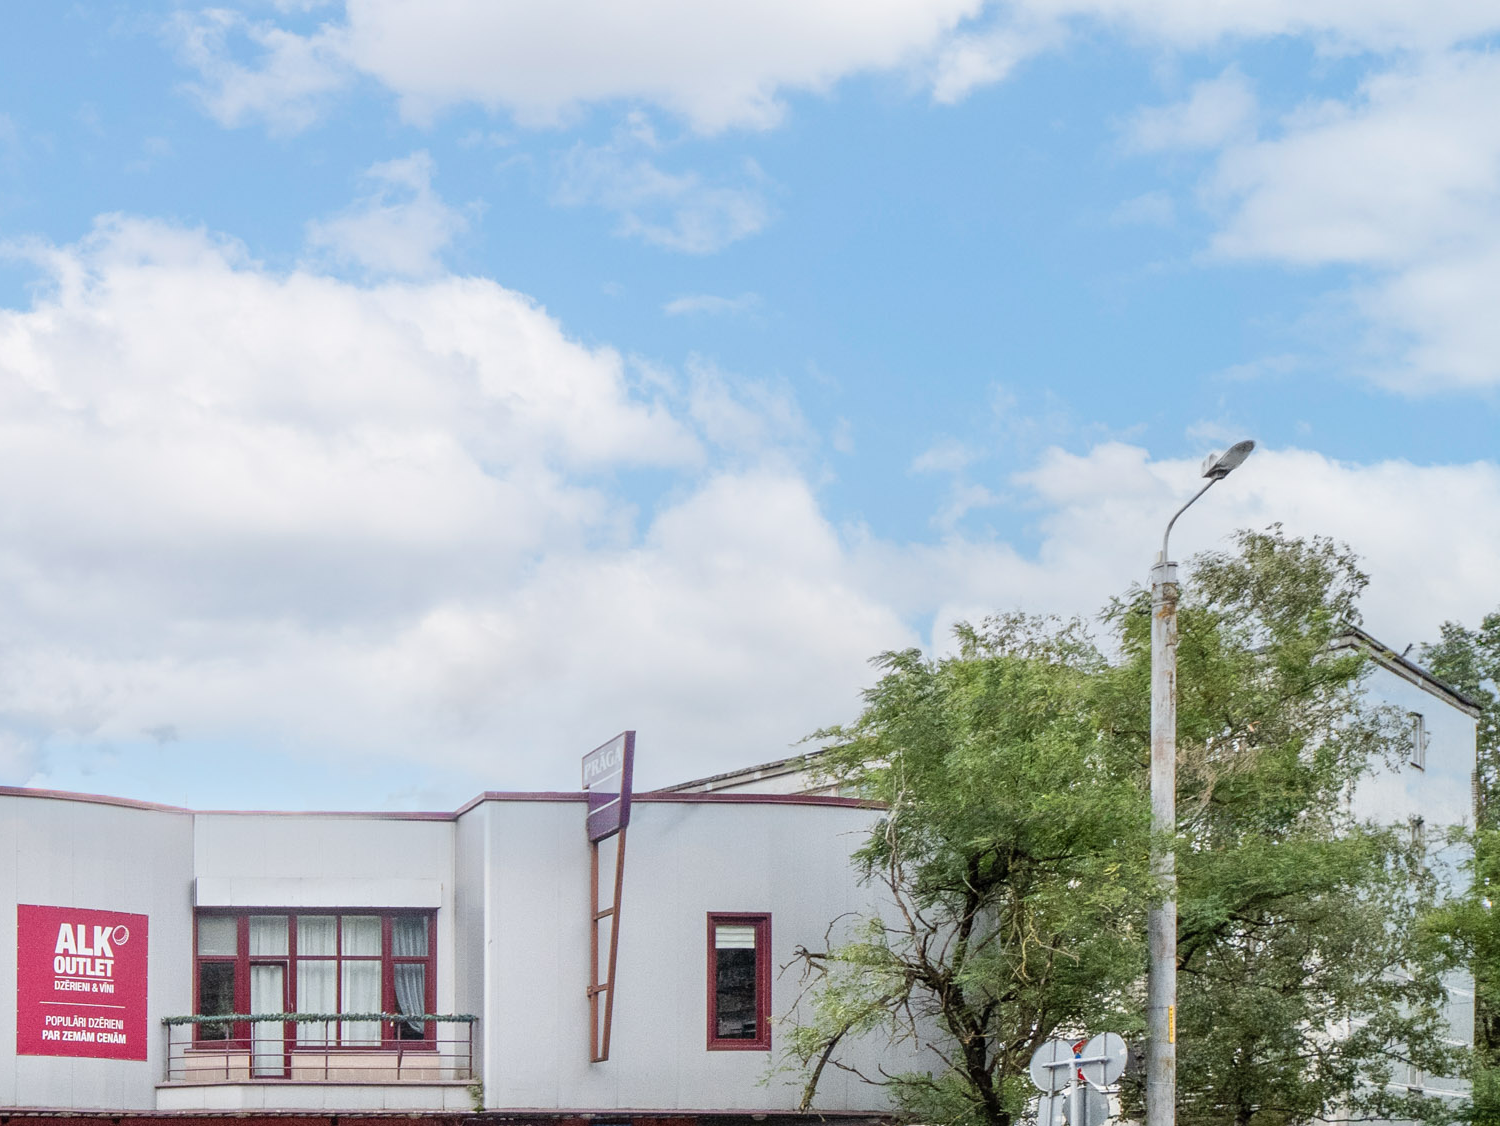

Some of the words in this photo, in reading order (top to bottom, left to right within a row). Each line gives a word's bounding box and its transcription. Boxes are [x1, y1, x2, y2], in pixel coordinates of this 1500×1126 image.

[584, 745, 622, 781] PRĀGA
[53, 956, 114, 977] OUTLET
[54, 980, 90, 992] DZĒRIENI
[92, 983, 98, 992] &
[99, 981, 114, 993] VĪNI
[45, 1015, 86, 1028] POPULĀRI
[88, 1017, 124, 1030] DZĒRIENI
[42, 1030, 60, 1040] PAR
[62, 1030, 95, 1042] ZEMĀM
[97, 1032, 126, 1044] CENĀM
